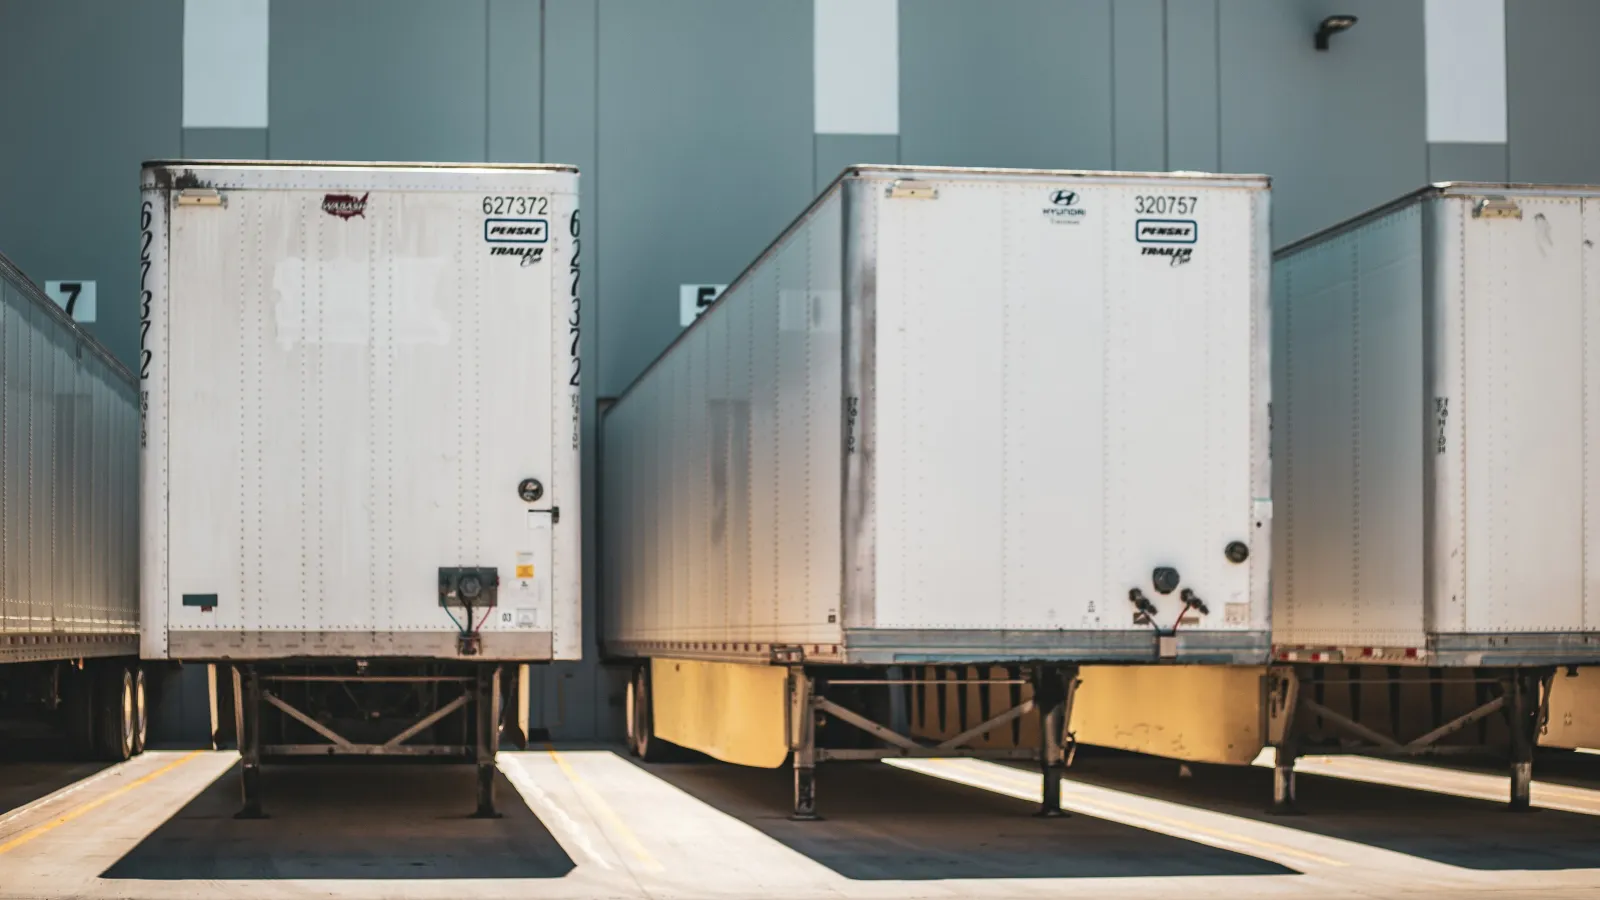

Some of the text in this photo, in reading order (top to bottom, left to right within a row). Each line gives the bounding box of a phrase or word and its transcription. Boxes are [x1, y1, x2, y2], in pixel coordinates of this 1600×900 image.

[482, 195, 548, 215] 627372
[1134, 195, 1198, 214] 320757
[490, 226, 541, 235] PENSKE
[1141, 227, 1191, 236] PENSKE
[489, 246, 545, 257] TRAILER
[1140, 246, 1193, 257] TRAILER
[59, 283, 82, 317] 7
[140, 201, 153, 380] 627372
[568, 208, 581, 387] 627372
